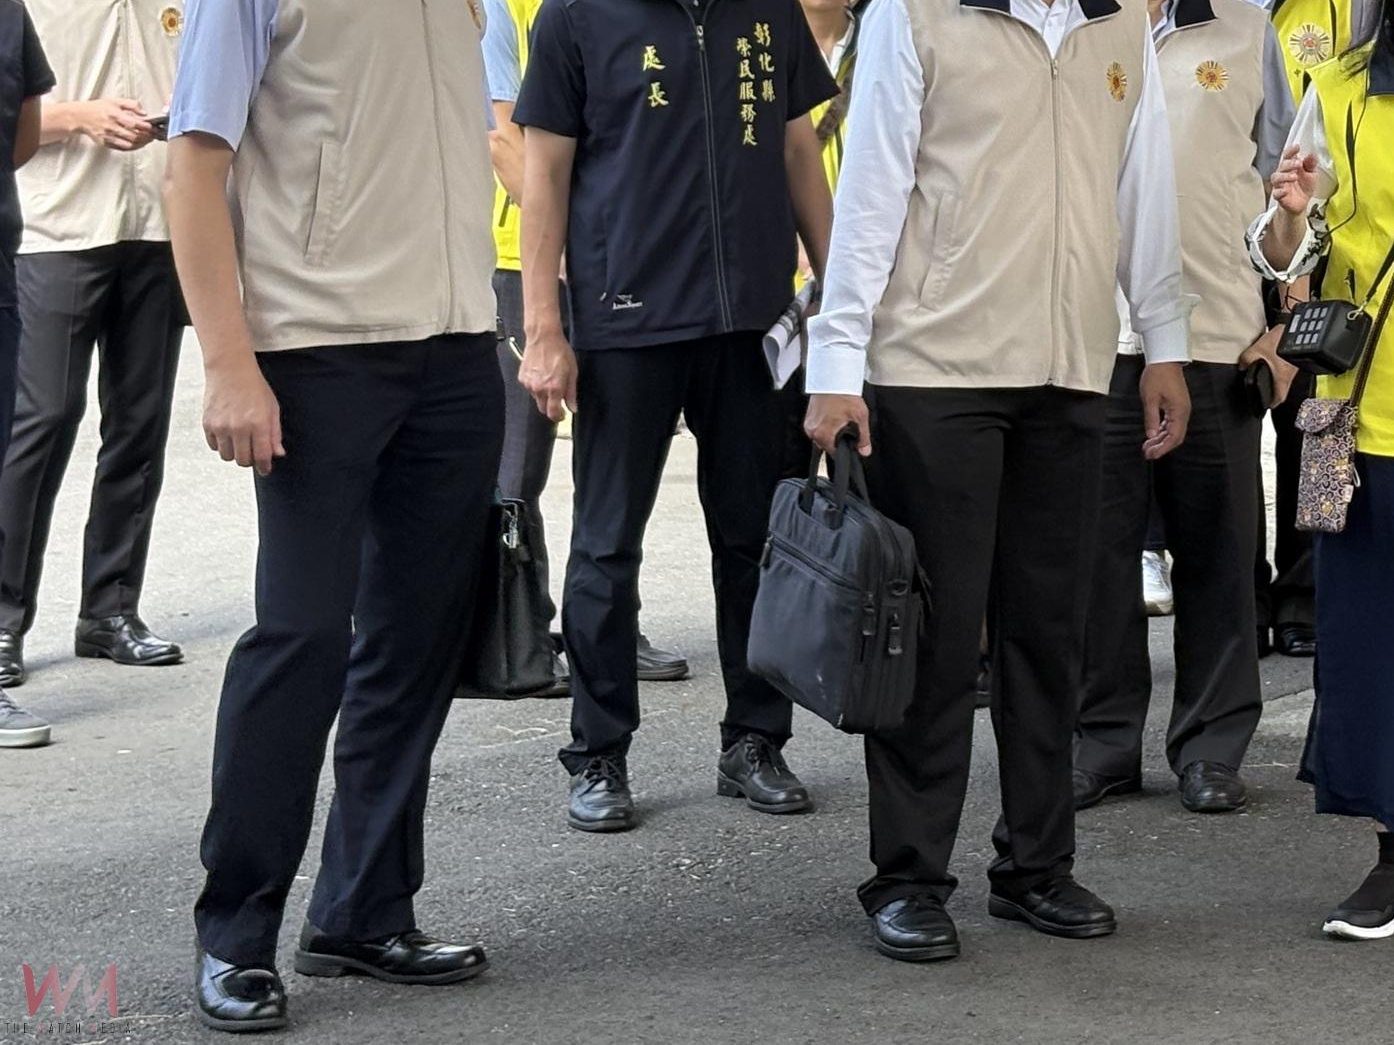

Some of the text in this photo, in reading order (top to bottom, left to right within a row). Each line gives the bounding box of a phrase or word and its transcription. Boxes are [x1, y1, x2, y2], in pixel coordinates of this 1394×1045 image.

[642, 45, 669, 108] 處長
[736, 37, 758, 146] 榮民服務處
[754, 22, 776, 103] 彰化縣
